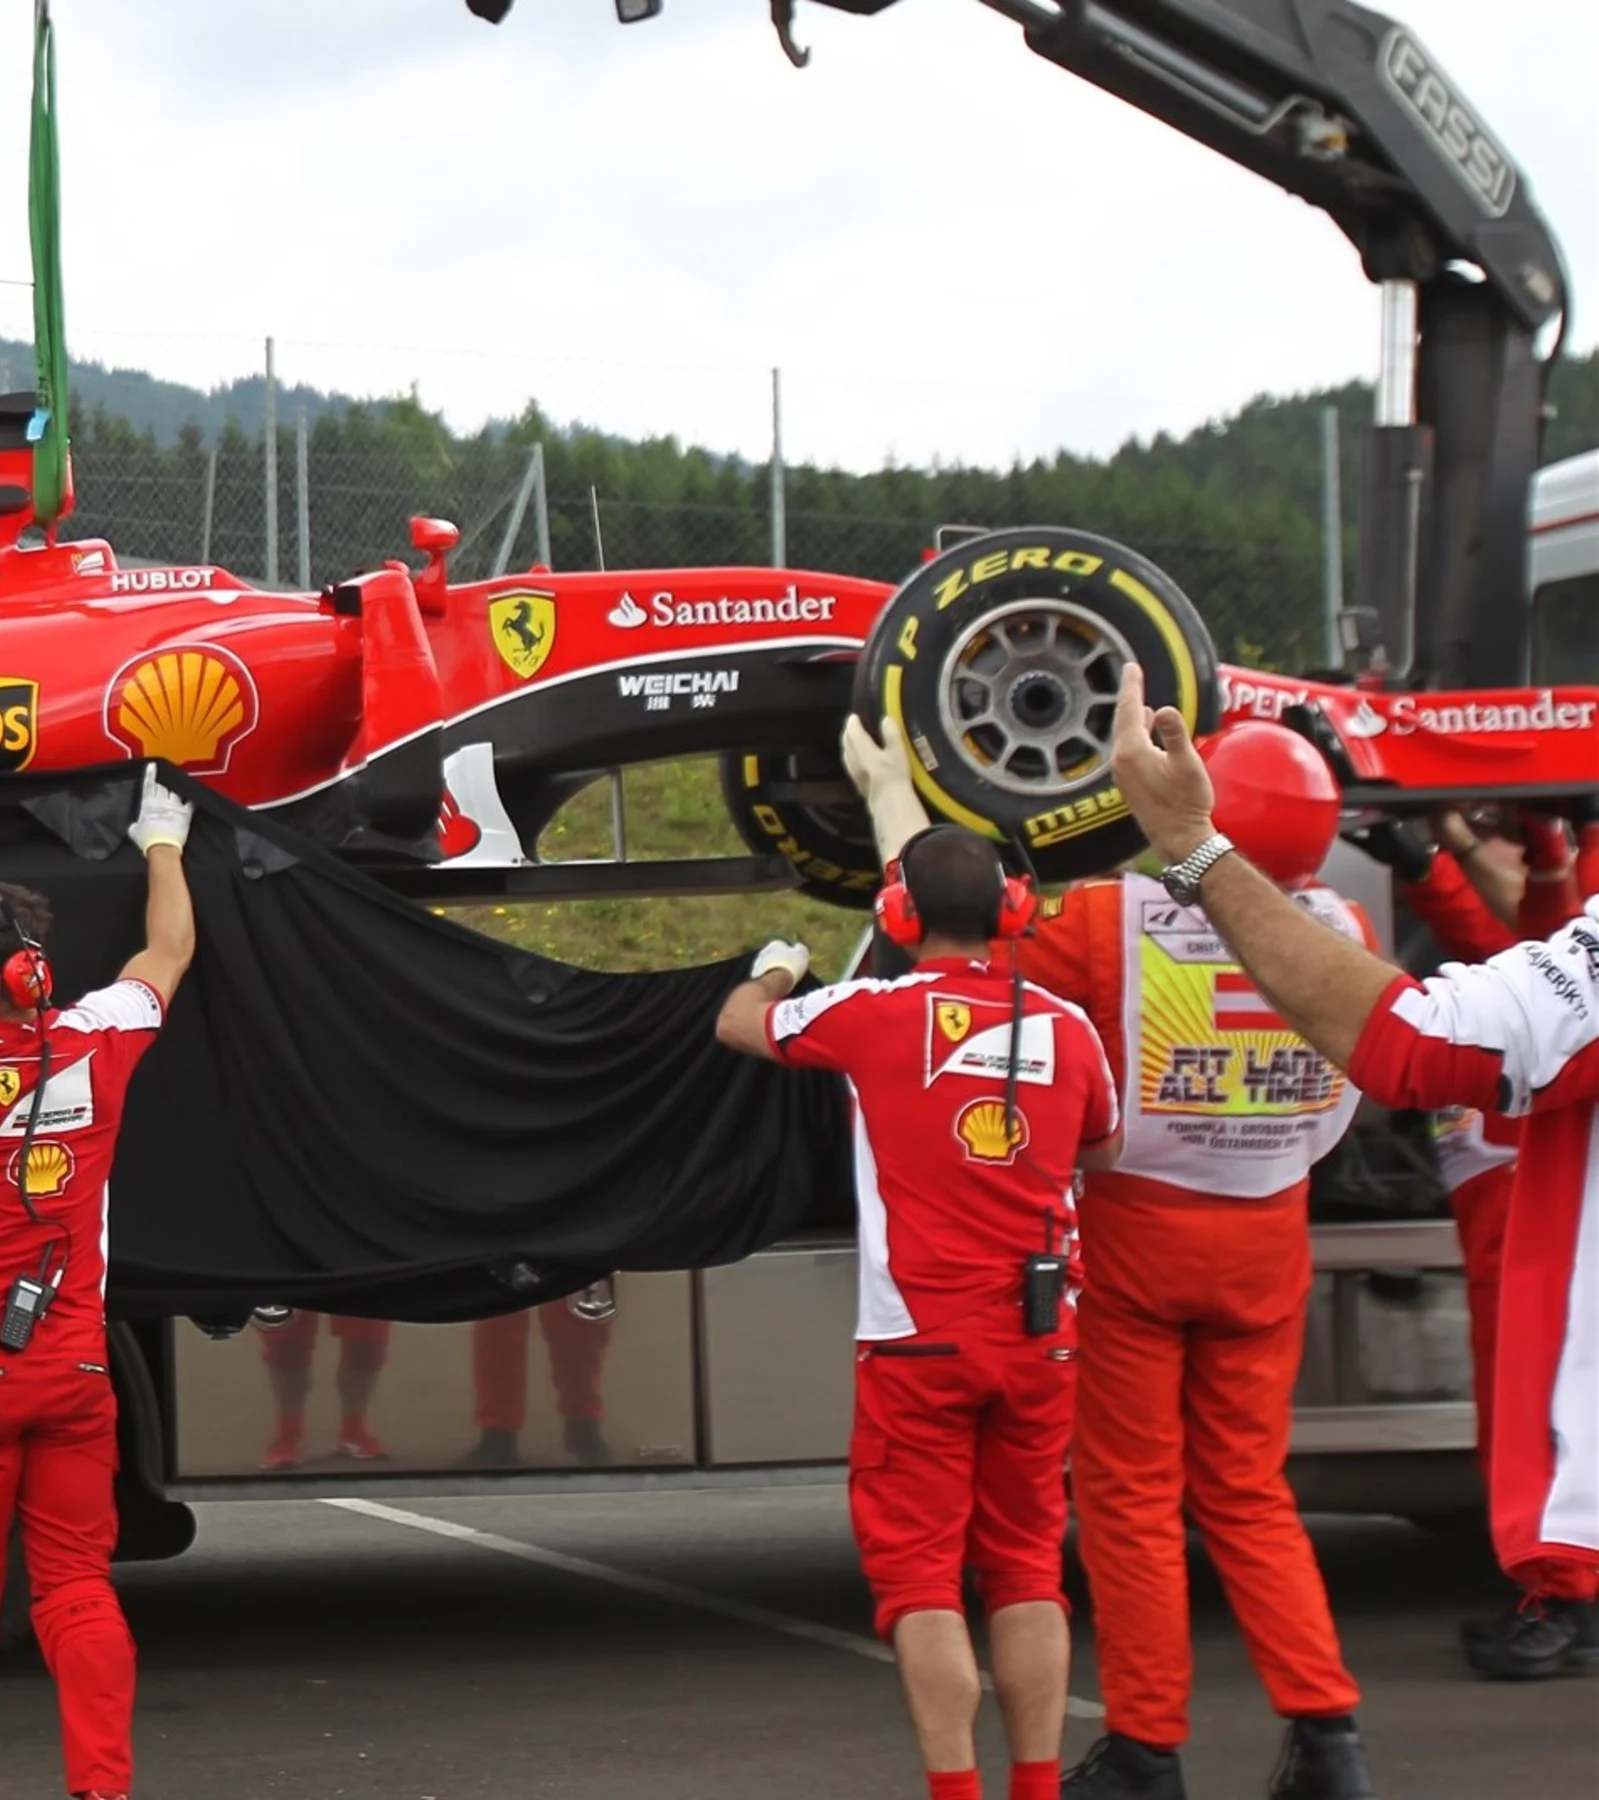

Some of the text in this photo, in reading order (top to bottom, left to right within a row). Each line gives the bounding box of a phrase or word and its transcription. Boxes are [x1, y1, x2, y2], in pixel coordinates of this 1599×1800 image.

[1394, 42, 1507, 202] FASSI
[111, 568, 215, 592] HUBLOT
[651, 584, 837, 628] Santander
[896, 546, 1104, 661] P ZERO
[619, 669, 740, 697] WEICHAI
[1389, 689, 1597, 735] Santander
[1023, 788, 1123, 837] RELLI
[1172, 1048, 1233, 1075] PIT
[1159, 1075, 1229, 1102] ALL
